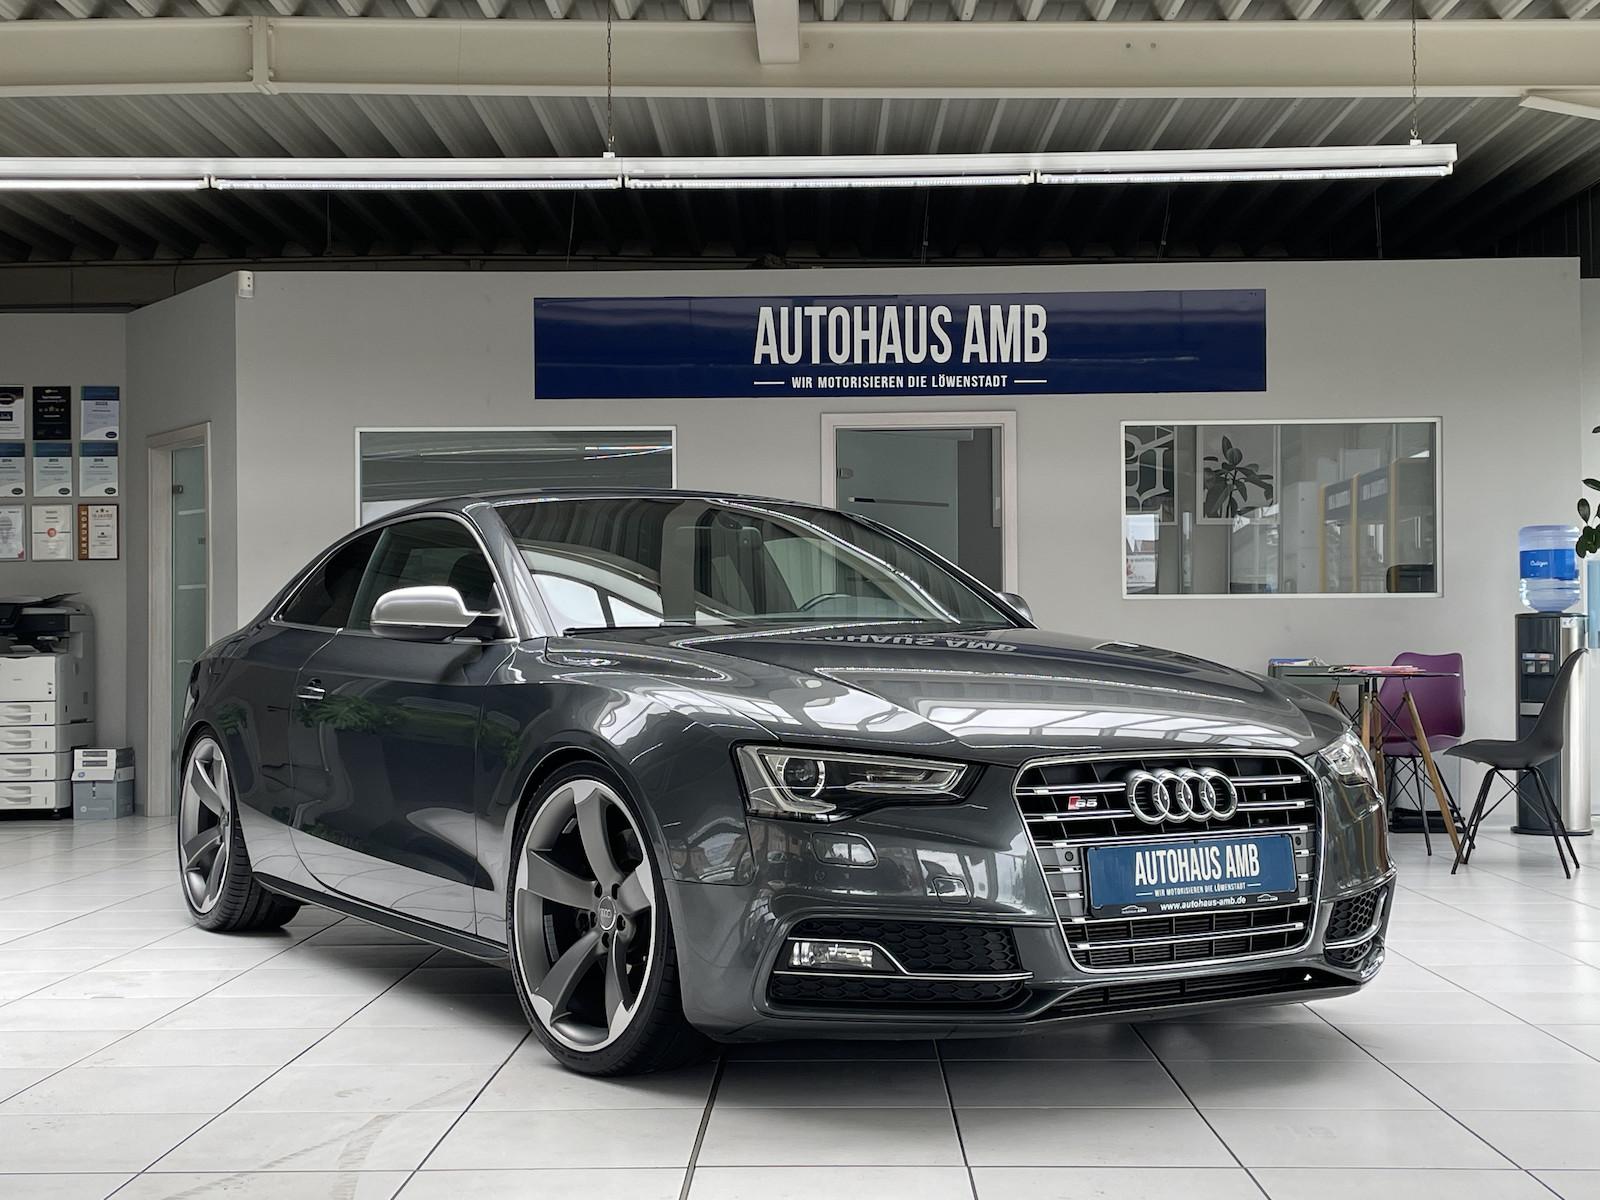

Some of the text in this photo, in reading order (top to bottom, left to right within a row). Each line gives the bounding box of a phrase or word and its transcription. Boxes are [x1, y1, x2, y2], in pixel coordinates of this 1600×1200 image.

[753, 304, 1048, 365] AUTOHAUS AMB
[791, 373, 1008, 389] WIR MOTORISIEREN DIE LÖWENSTADT
[1135, 843, 1260, 886] AUTOHAUS AMB
[1160, 896, 1247, 911] www.autohaus-amb.de
